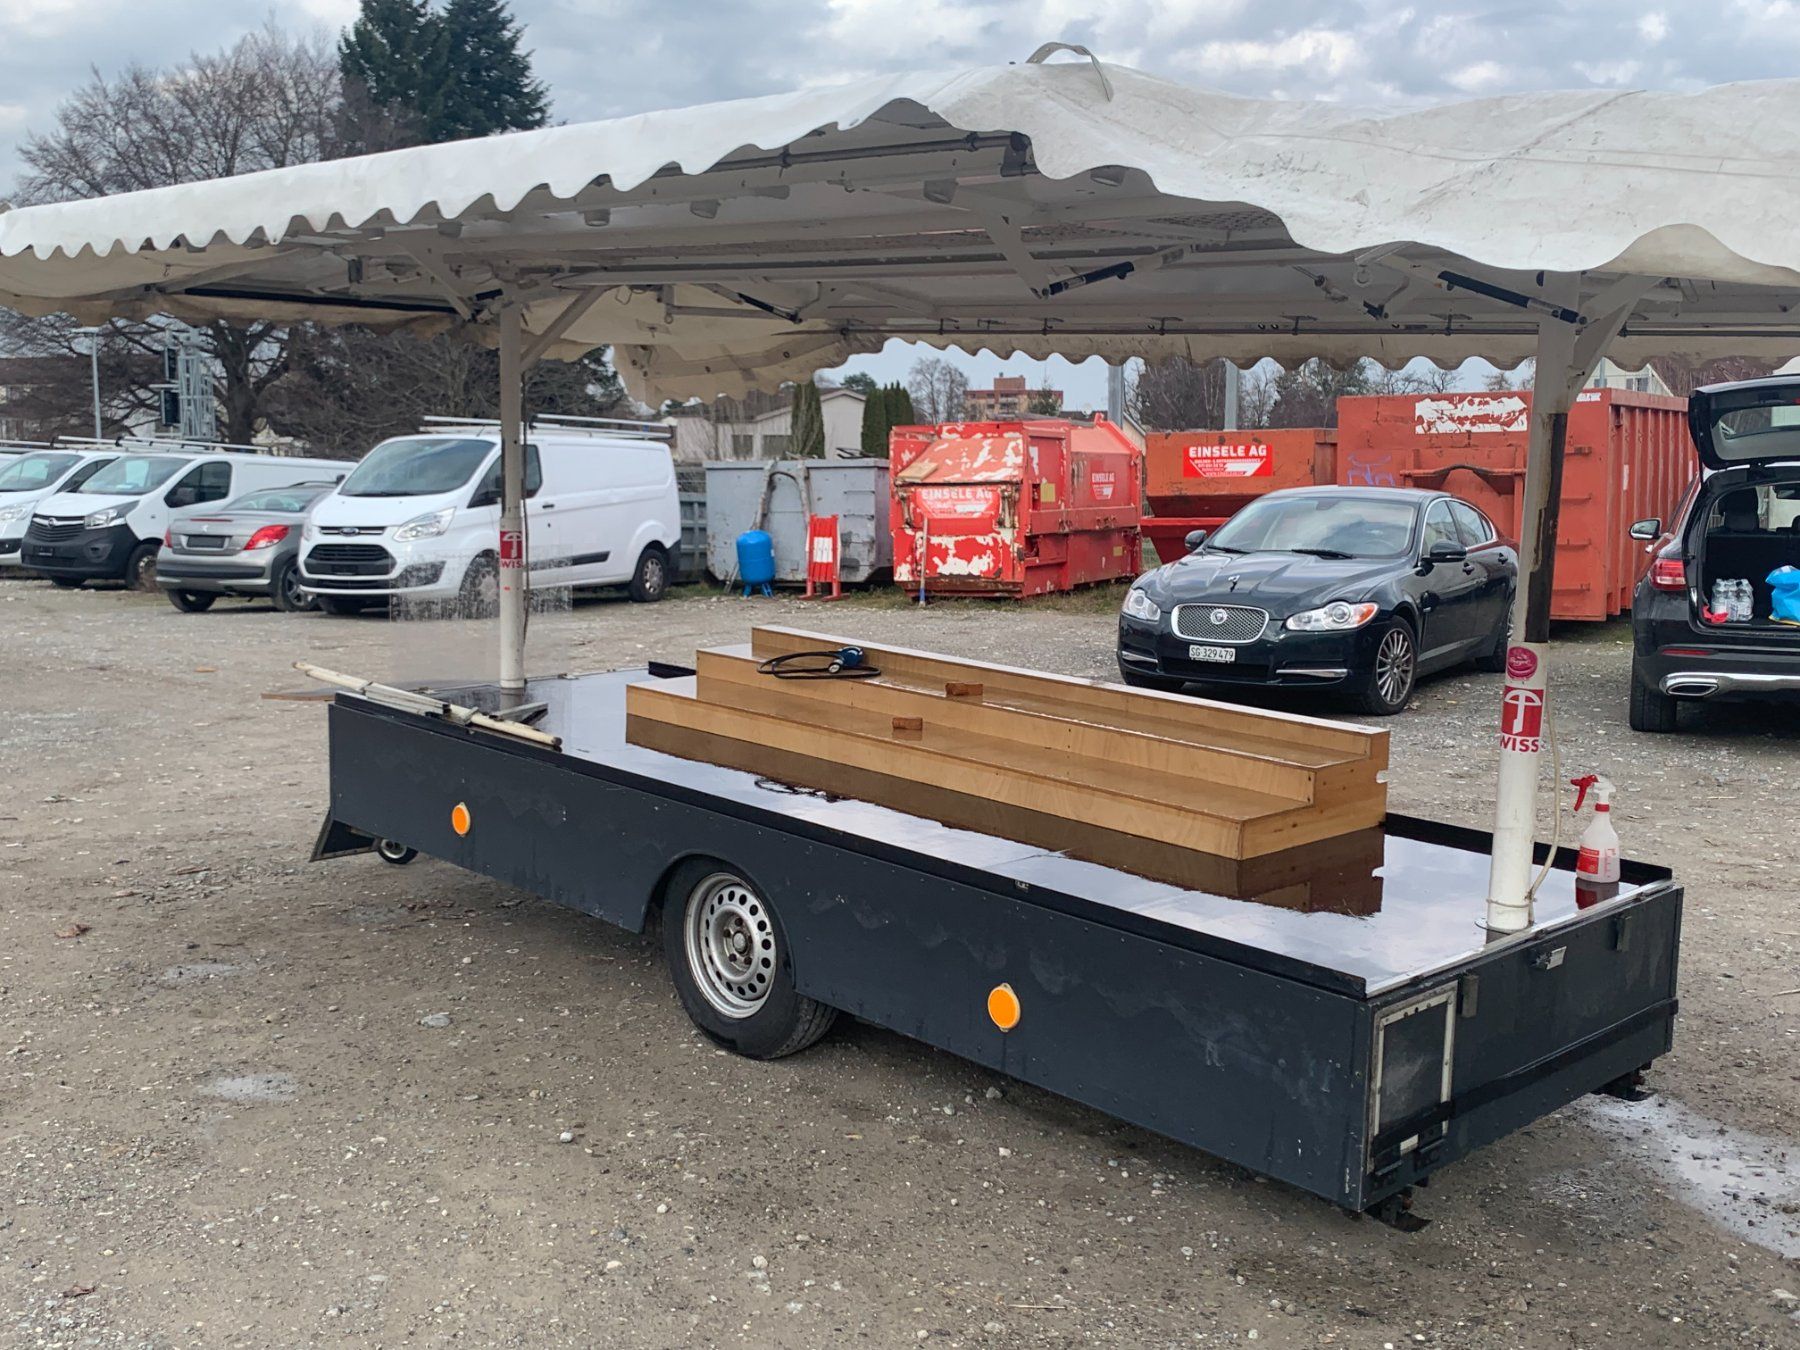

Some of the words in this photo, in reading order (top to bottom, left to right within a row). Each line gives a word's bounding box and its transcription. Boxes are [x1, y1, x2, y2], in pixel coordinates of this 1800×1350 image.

[1189, 446, 1246, 458] EINSELE
[1249, 445, 1267, 457] AG
[921, 488, 973, 500] EINSELE
